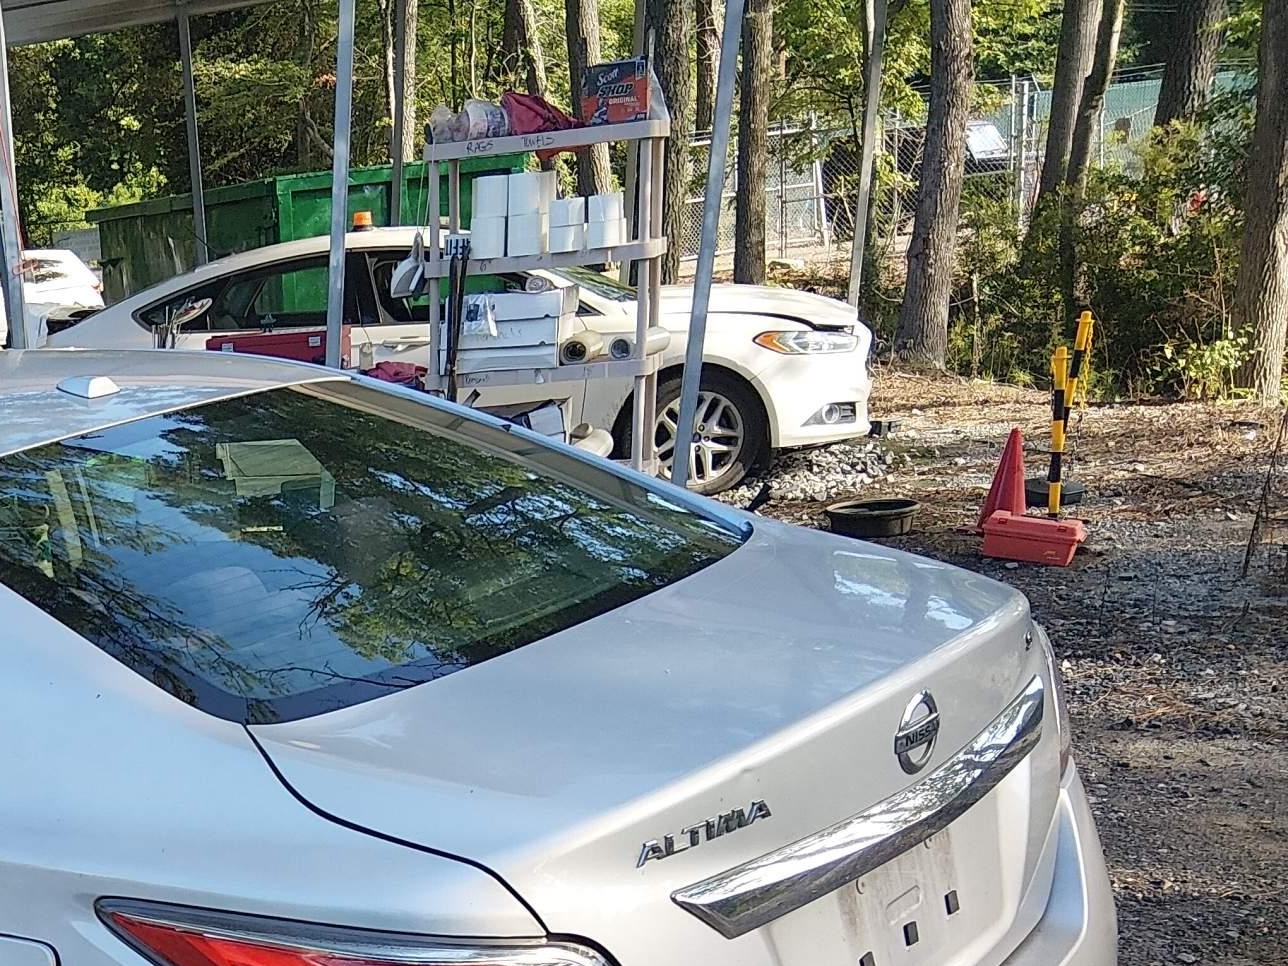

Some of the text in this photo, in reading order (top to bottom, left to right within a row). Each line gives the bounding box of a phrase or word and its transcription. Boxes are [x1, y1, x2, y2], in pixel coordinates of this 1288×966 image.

[597, 67, 619, 86] Scott
[598, 82, 634, 98] SHOP
[608, 96, 639, 105] ORIGINAL
[466, 141, 494, 153] RAGS
[636, 799, 772, 868] ALTIMA
